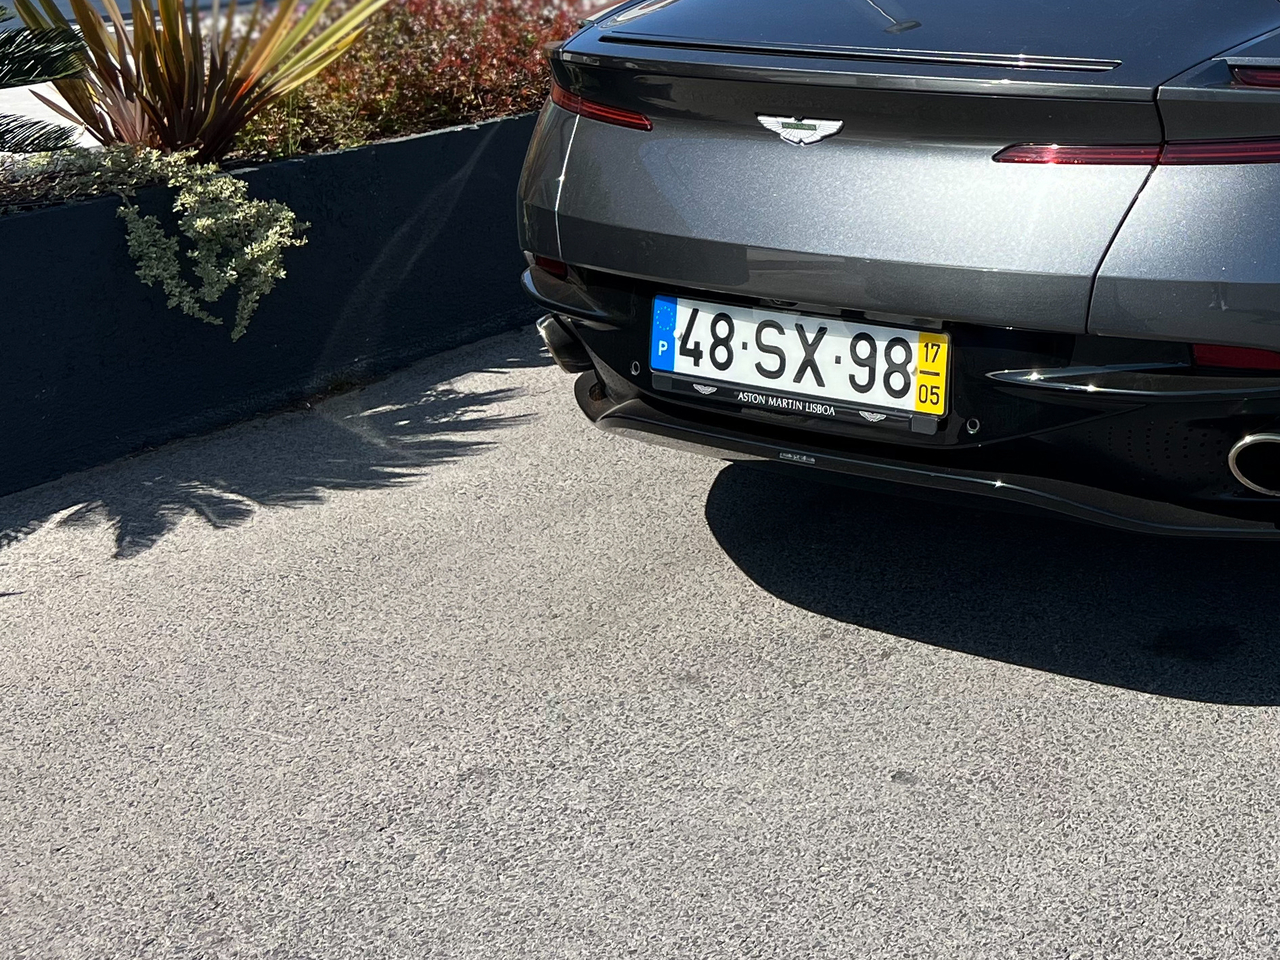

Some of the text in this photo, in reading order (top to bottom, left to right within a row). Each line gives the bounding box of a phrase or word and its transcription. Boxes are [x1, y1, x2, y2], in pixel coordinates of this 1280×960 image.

[658, 339, 668, 356] P
[924, 342, 941, 363] 17
[738, 391, 836, 416] ASTON MARTIN LISBOA
[918, 384, 940, 406] 05
